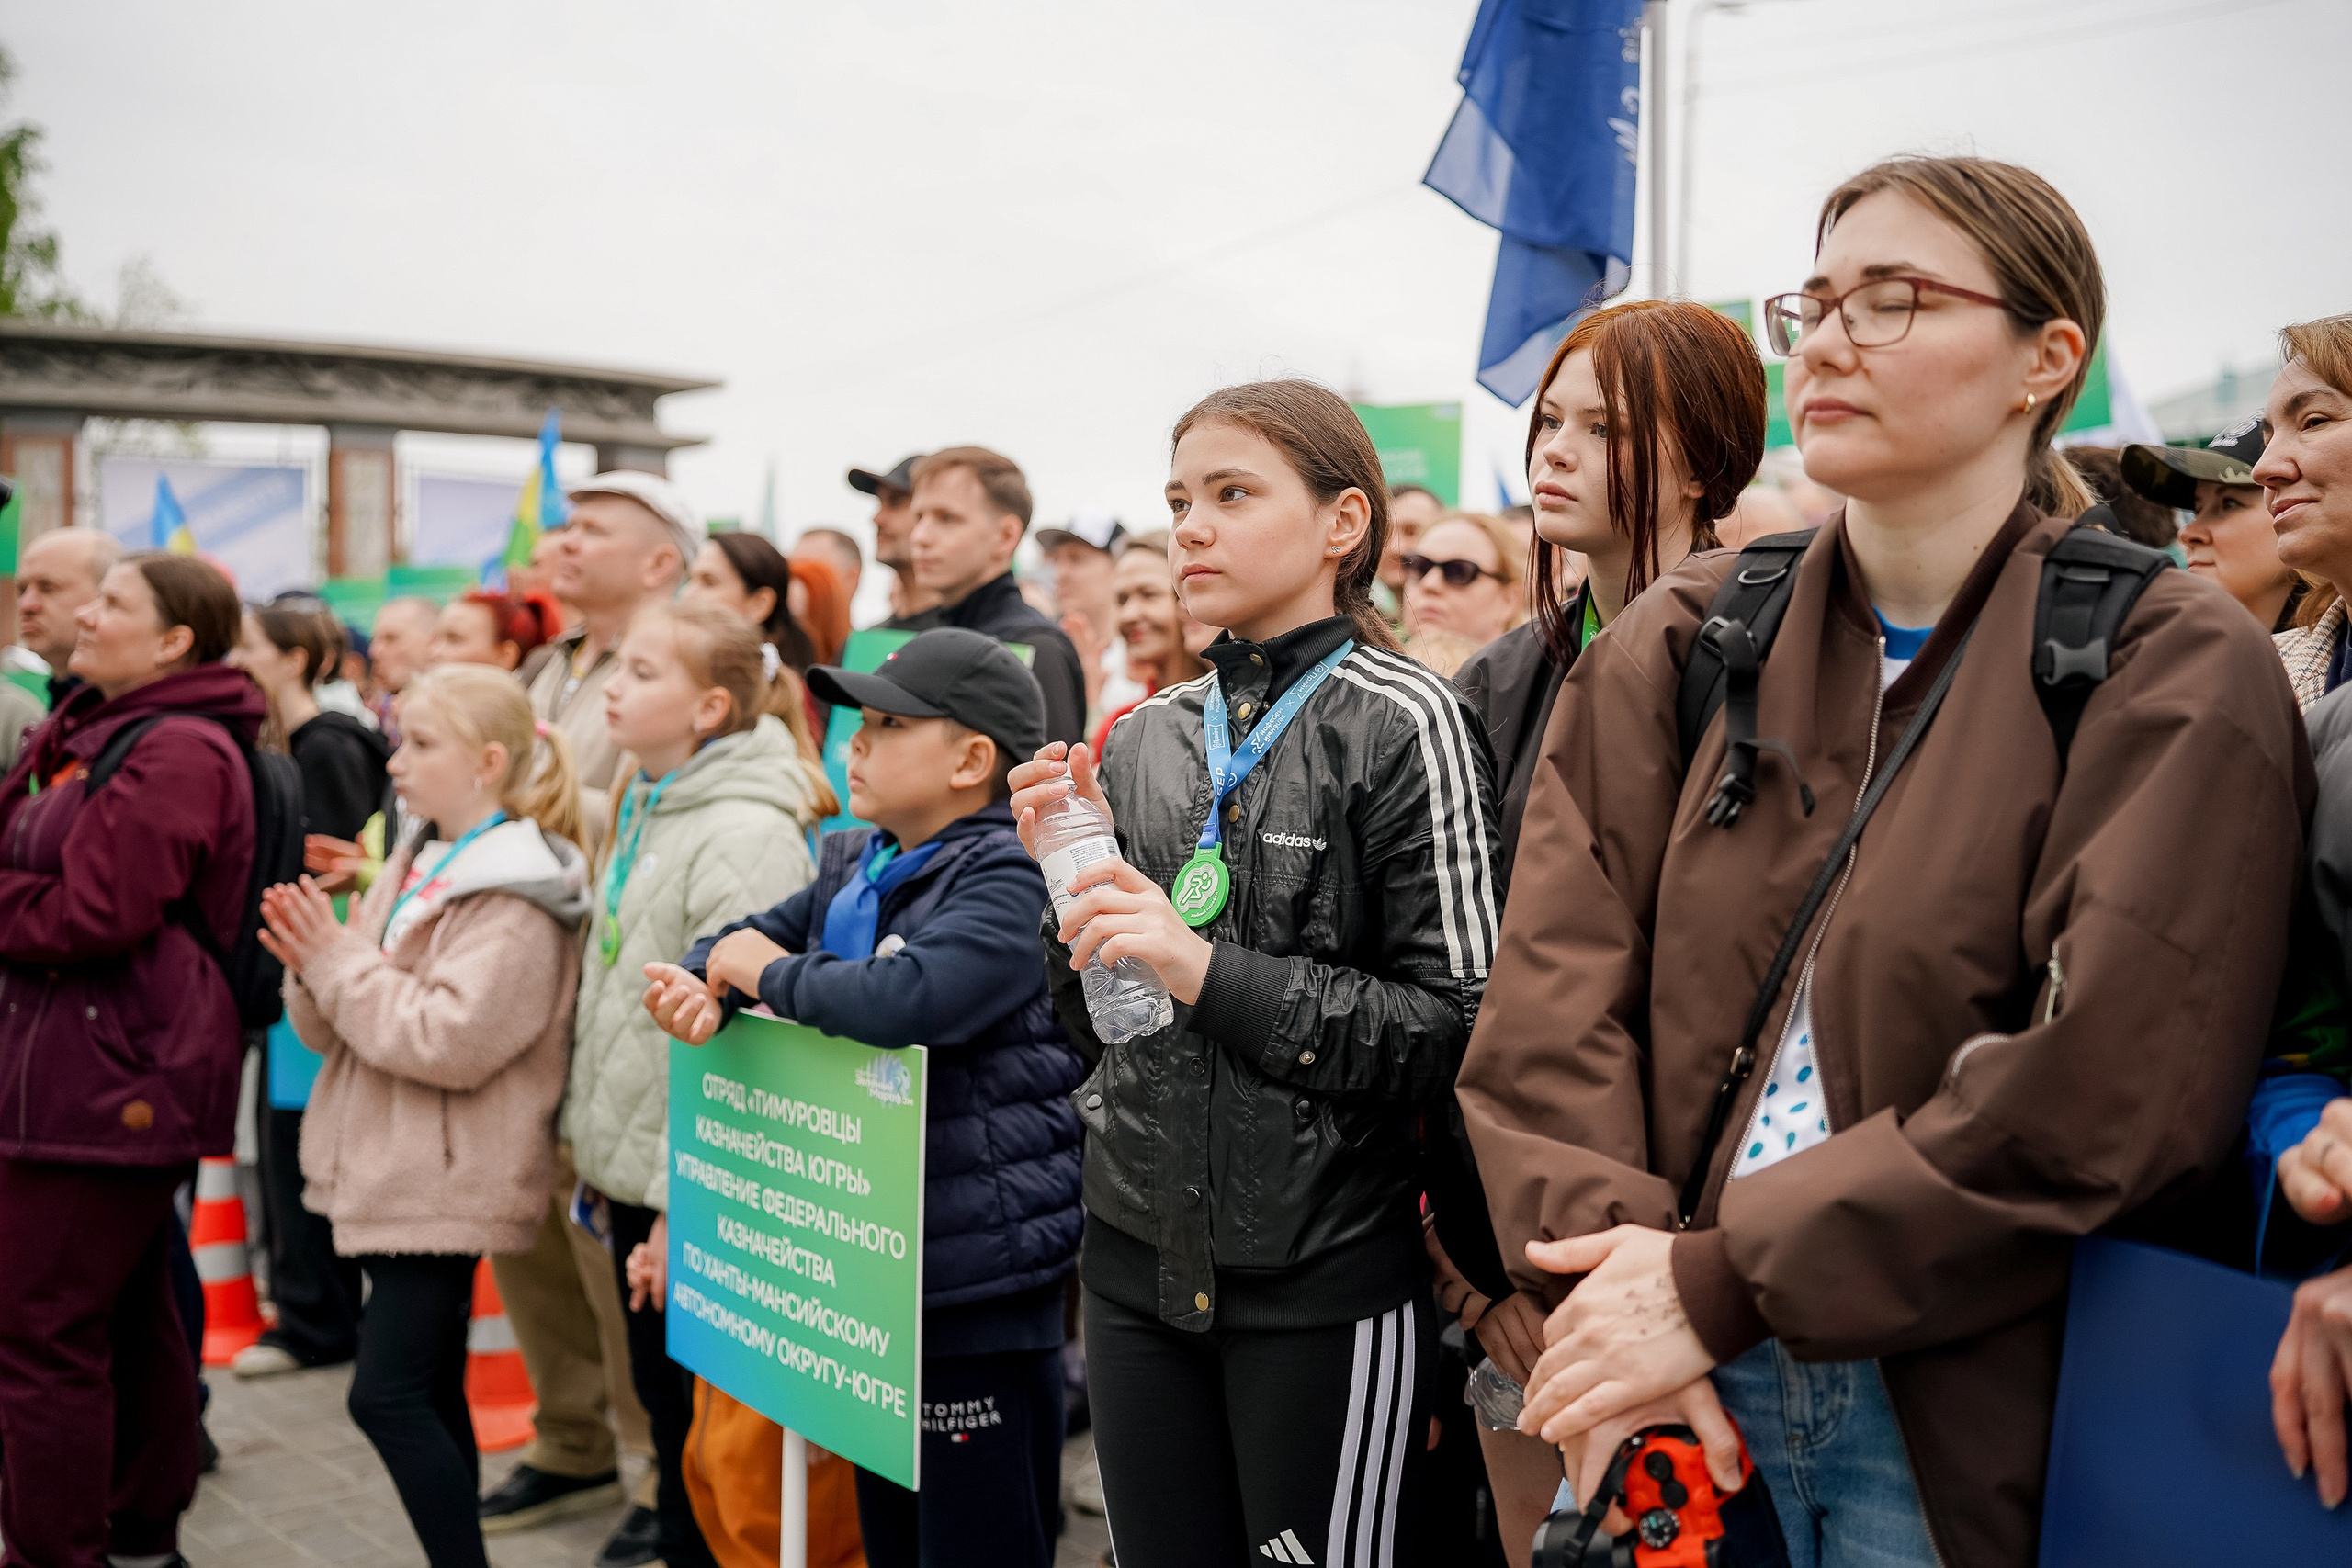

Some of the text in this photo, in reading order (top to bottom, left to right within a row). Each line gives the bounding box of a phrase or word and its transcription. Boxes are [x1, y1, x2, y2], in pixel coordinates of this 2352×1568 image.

[1262, 832, 1311, 847] adidas
[702, 1072, 862, 1145] ОТРЯД «ТИМУРОВЦЫ
[695, 1113, 871, 1196] КАЗНАЧЕЙСТВА ЮГРЫ»
[674, 1149, 906, 1259] УПРАВЛЕНИЕ ФЕДЕРАЛЬНОГО
[717, 1213, 836, 1289] КАЗНАЧЕЙСТВА
[683, 1241, 890, 1358] ПО ХАНТЫ-МАНСИЙСКОМУ
[673, 1280, 906, 1418] АВТОНОМНОМУ ОКРУГУ-ЮГРЕ
[922, 1395, 994, 1417] TOMMY
